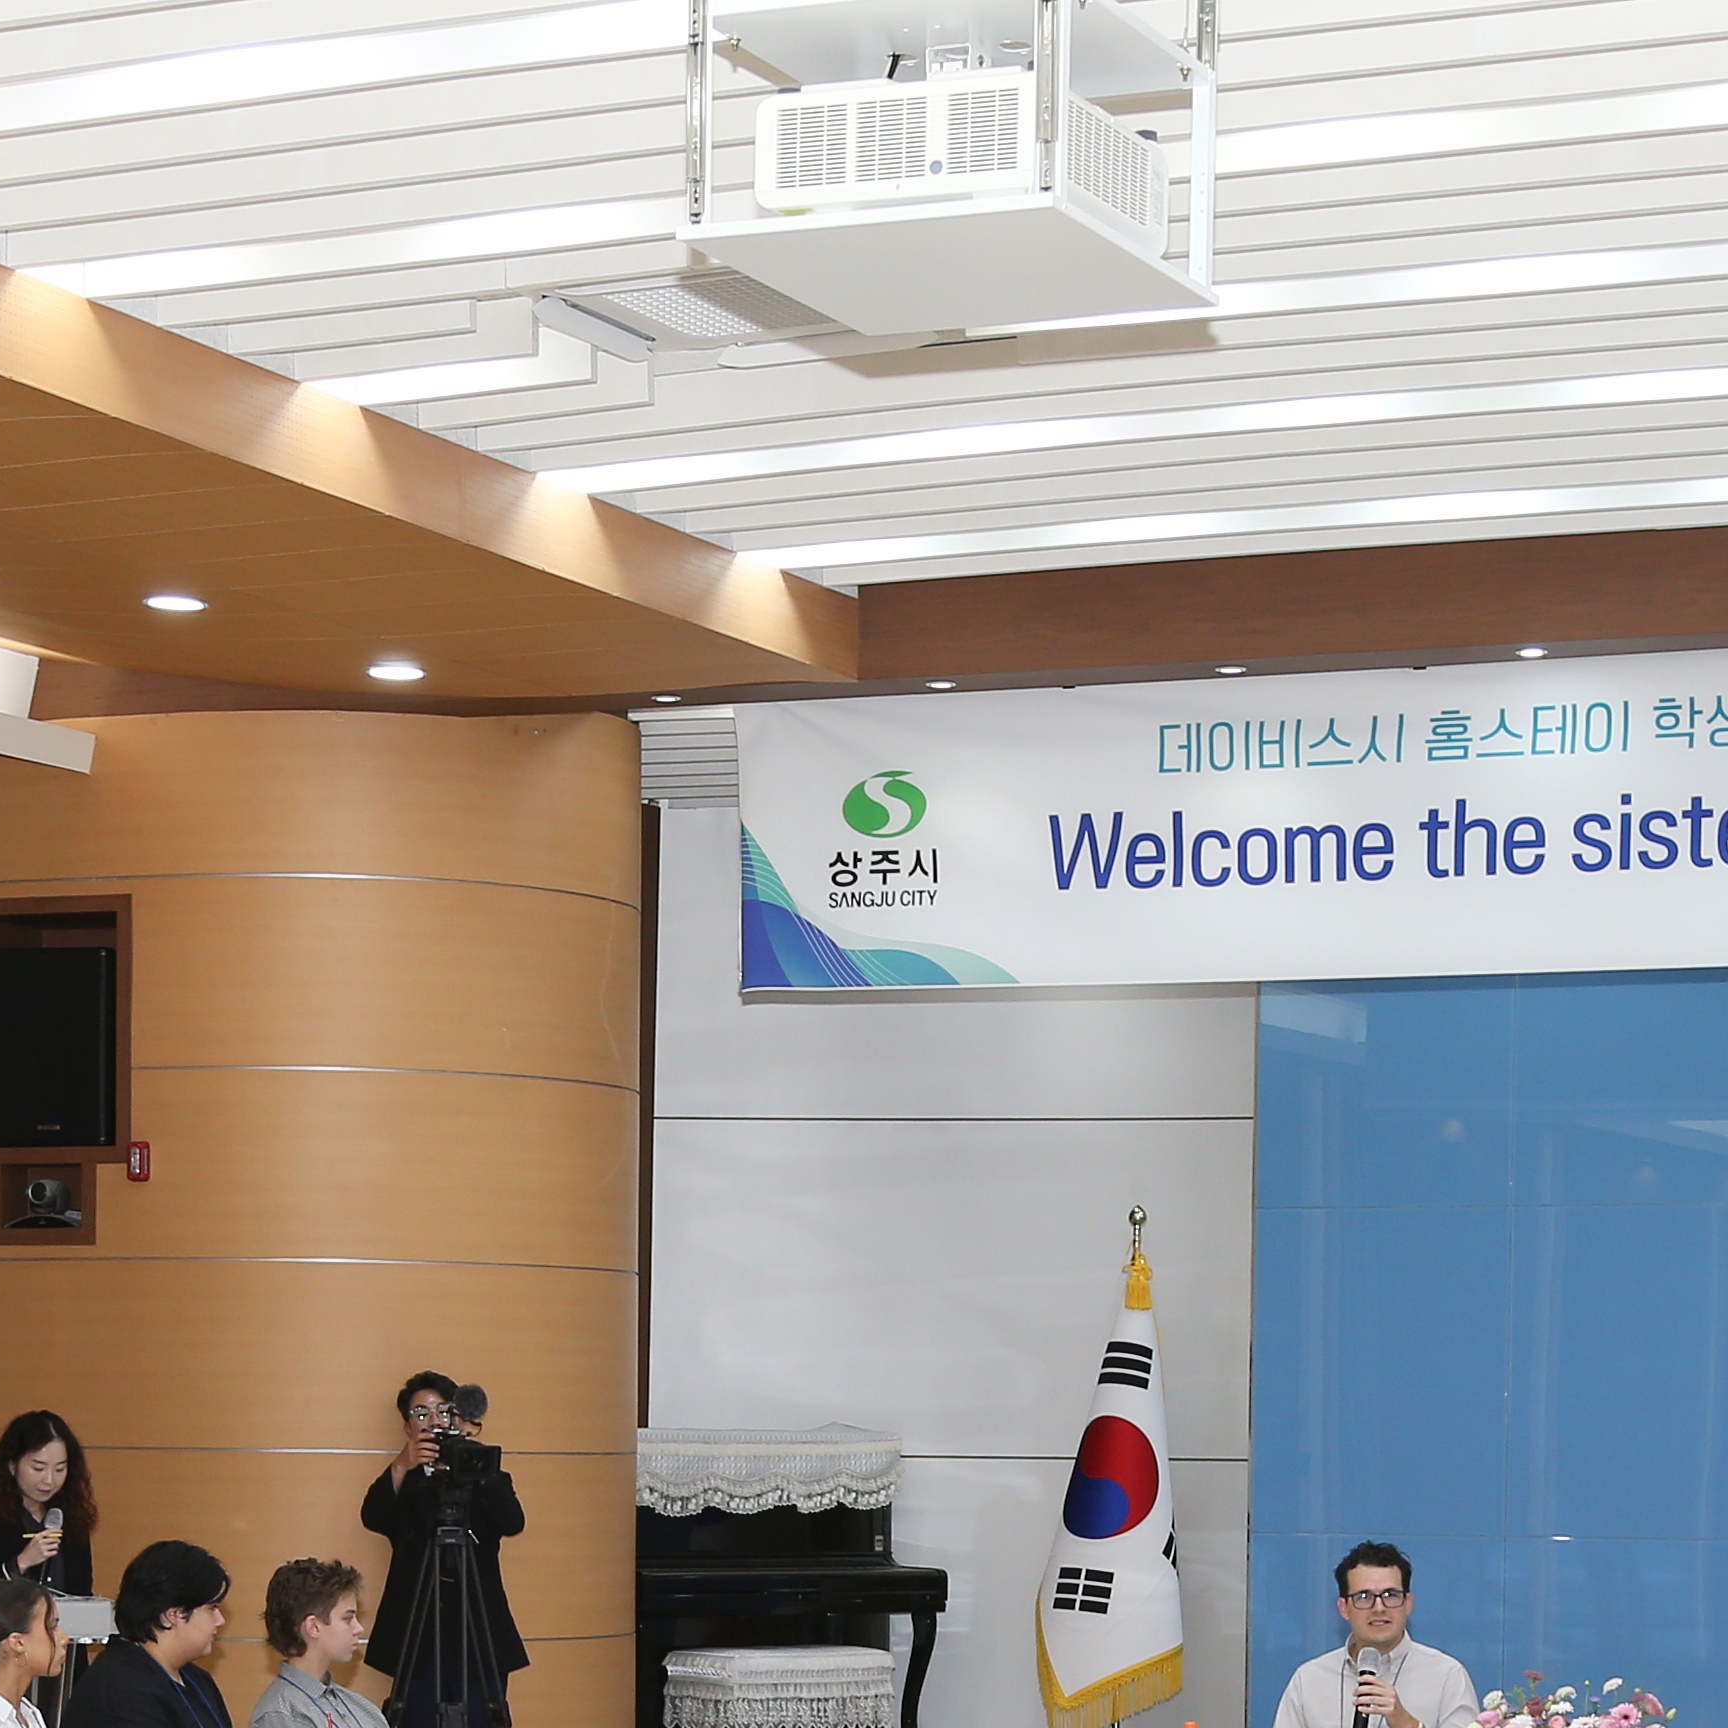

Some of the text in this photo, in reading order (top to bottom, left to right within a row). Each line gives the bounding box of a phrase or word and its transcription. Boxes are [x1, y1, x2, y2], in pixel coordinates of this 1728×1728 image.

[1158, 713, 1405, 774] 데이비스시
[1425, 699, 1631, 762] 홈스테이
[828, 848, 939, 888] 상주시
[1047, 809, 1395, 891] Welcome
[1418, 797, 1547, 878] the
[828, 889, 938, 909] SANGJU CITY
